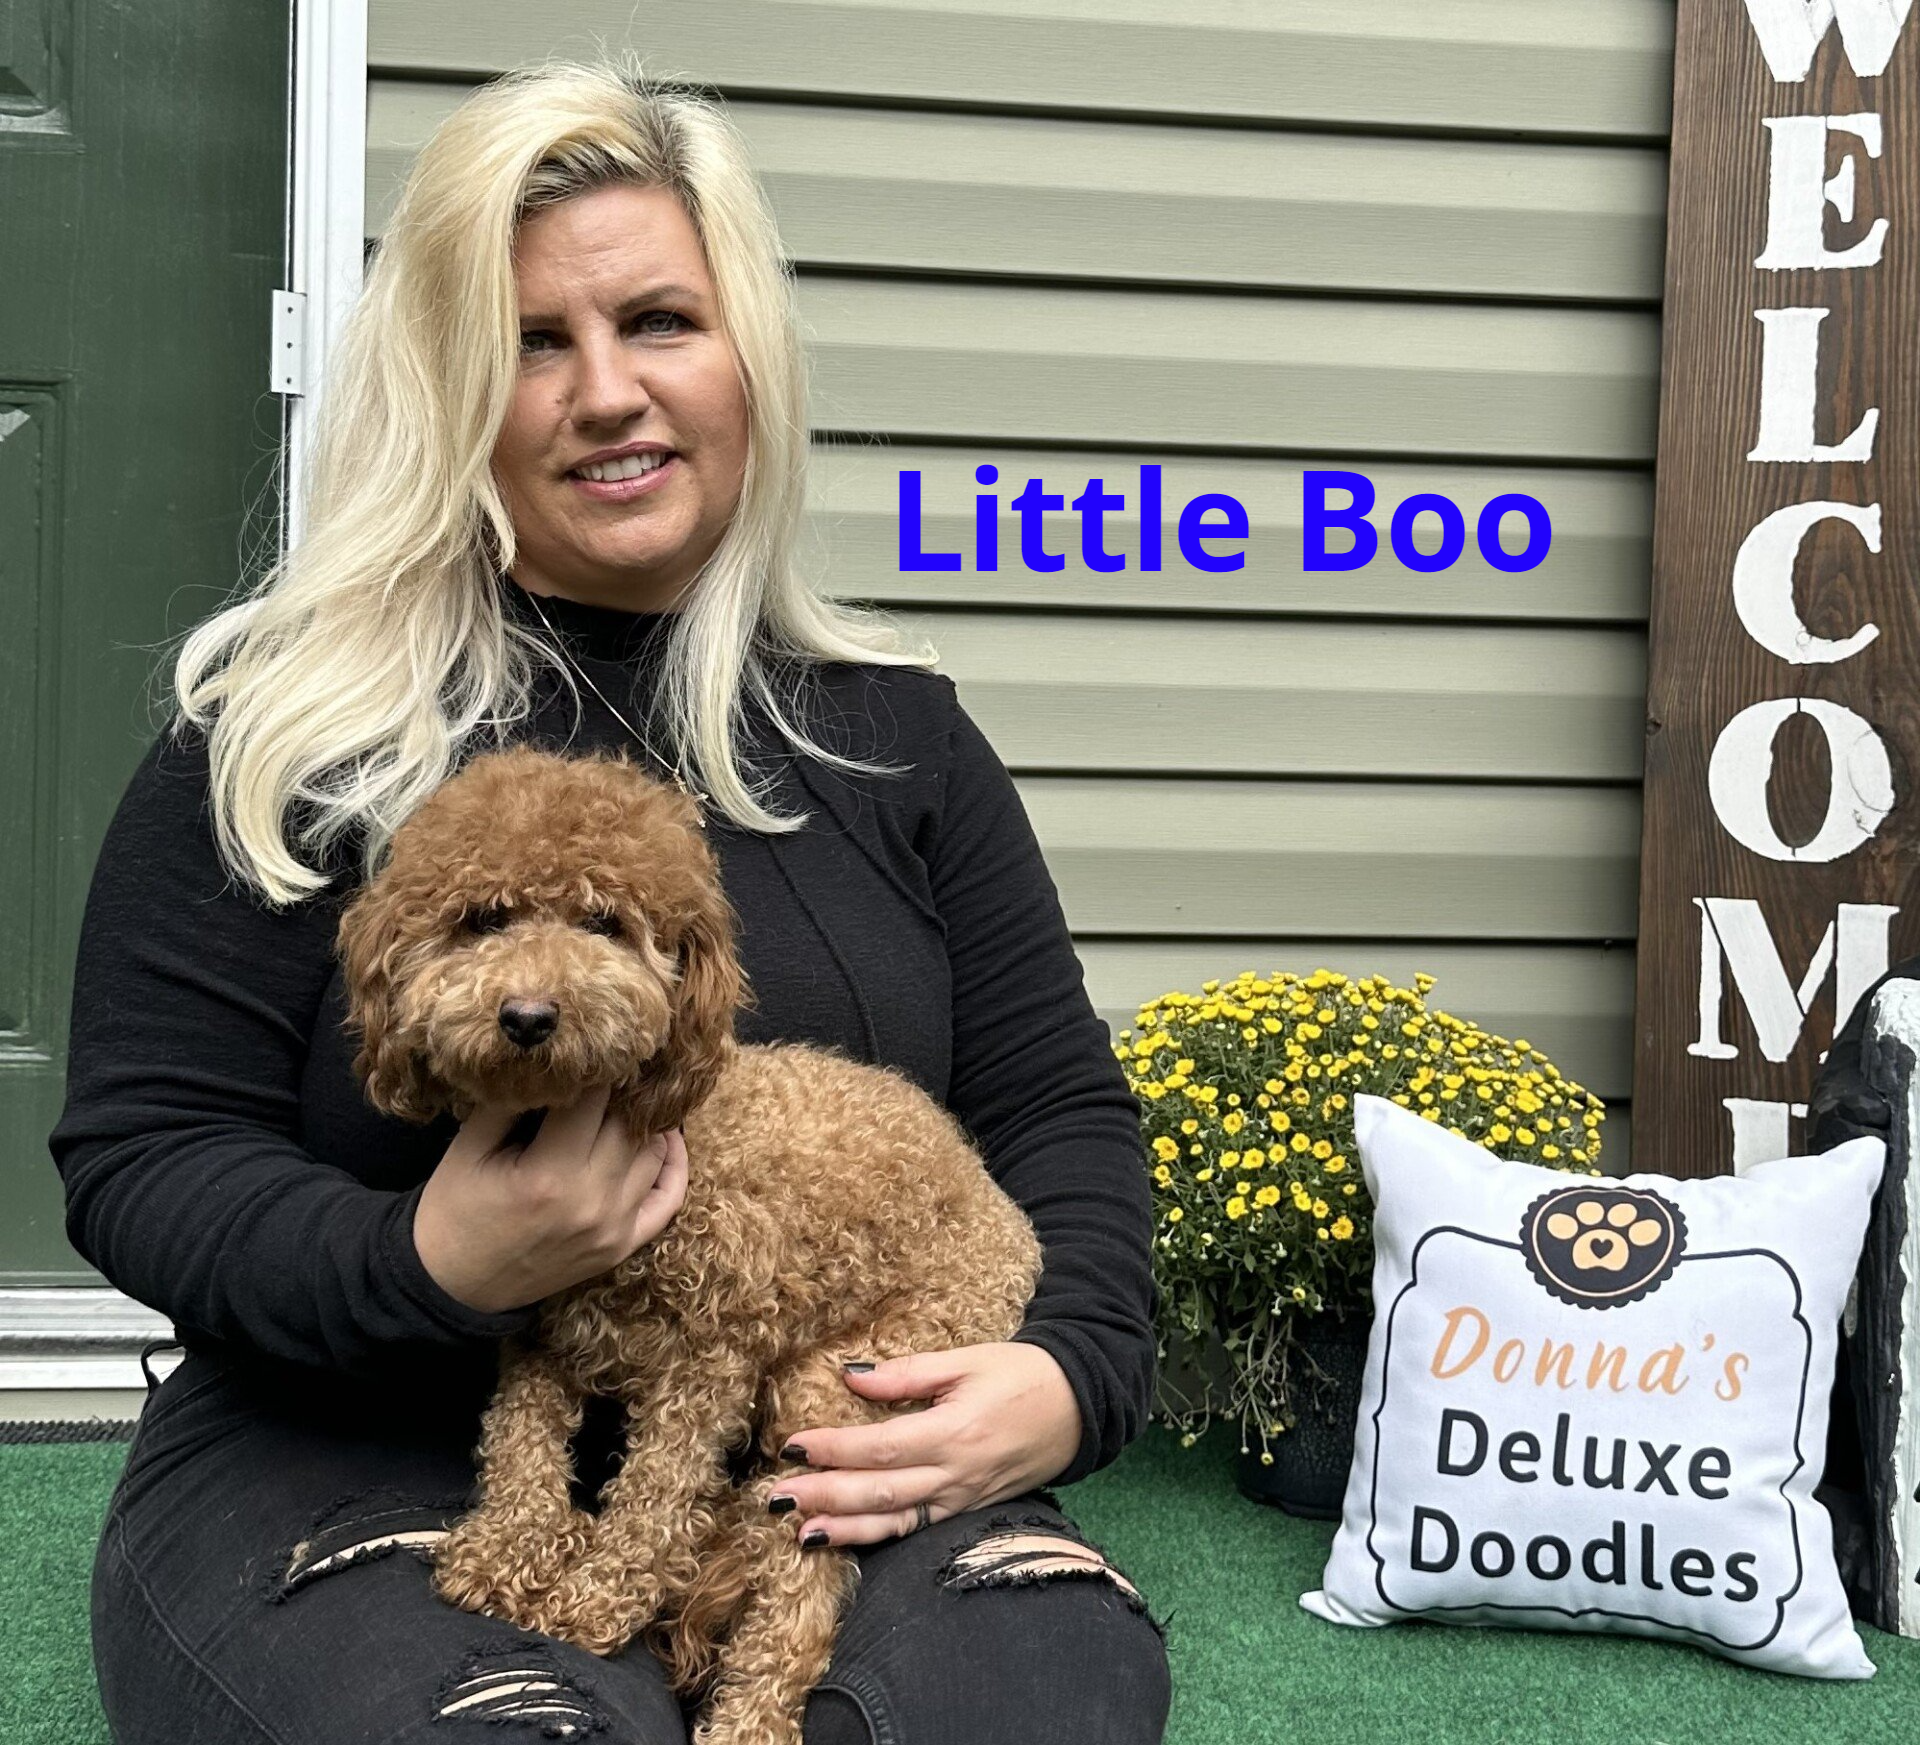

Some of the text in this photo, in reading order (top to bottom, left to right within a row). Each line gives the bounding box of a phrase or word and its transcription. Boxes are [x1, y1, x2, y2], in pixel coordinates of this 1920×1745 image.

[1429, 1305, 1750, 1401] Donna's
[1437, 1408, 1732, 1501] Deluxe
[1410, 1505, 1759, 1603] Doodles
